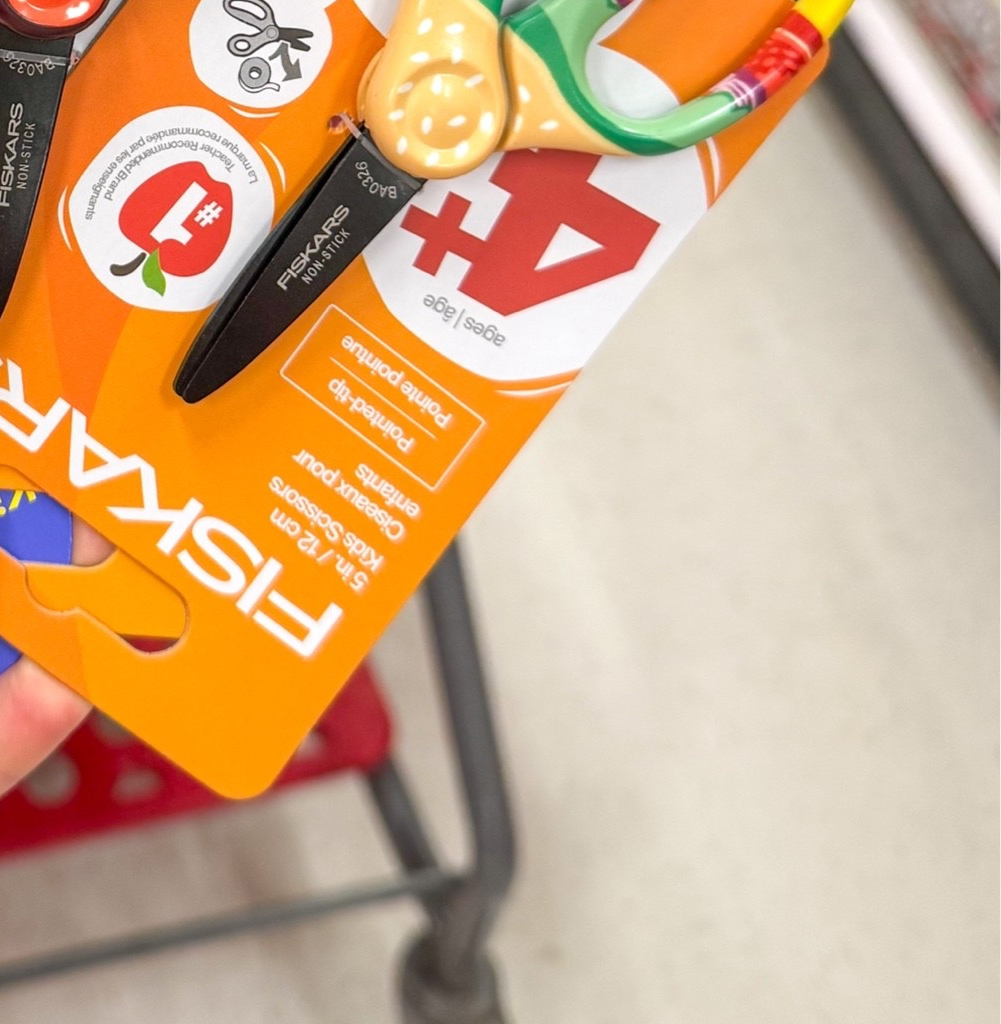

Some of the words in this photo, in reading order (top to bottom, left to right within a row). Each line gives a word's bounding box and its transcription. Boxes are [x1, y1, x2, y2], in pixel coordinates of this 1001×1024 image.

[131, 135, 146, 154] par
[145, 127, 222, 143] recommandée
[16, 122, 36, 190] NON-STICK
[116, 149, 131, 163] les
[125, 140, 199, 174] Recommended
[200, 142, 235, 173] Teacher
[221, 137, 251, 171] marque
[85, 161, 117, 220] enseignants
[104, 170, 128, 201] Brand
[248, 169, 259, 185] La
[355, 161, 397, 199] BA0326
[150, 180, 224, 246] #1
[276, 204, 350, 291] FISKARS
[399, 148, 661, 317] 4+
[301, 227, 351, 285] NON-STICK
[423, 293, 456, 322] âge
[463, 316, 506, 347] ages
[341, 334, 404, 386] pointue
[328, 377, 416, 454] Pointed-tip
[400, 379, 453, 430] Pointe
[292, 448, 340, 485] pour
[268, 475, 344, 542] Scissors
[355, 463, 421, 518] enfants
[270, 507, 301, 538] cm
[334, 478, 405, 542] Ciseaux
[297, 529, 322, 555] 12
[342, 531, 384, 573] Kids
[335, 553, 353, 583] in.
[349, 571, 369, 595] 5
